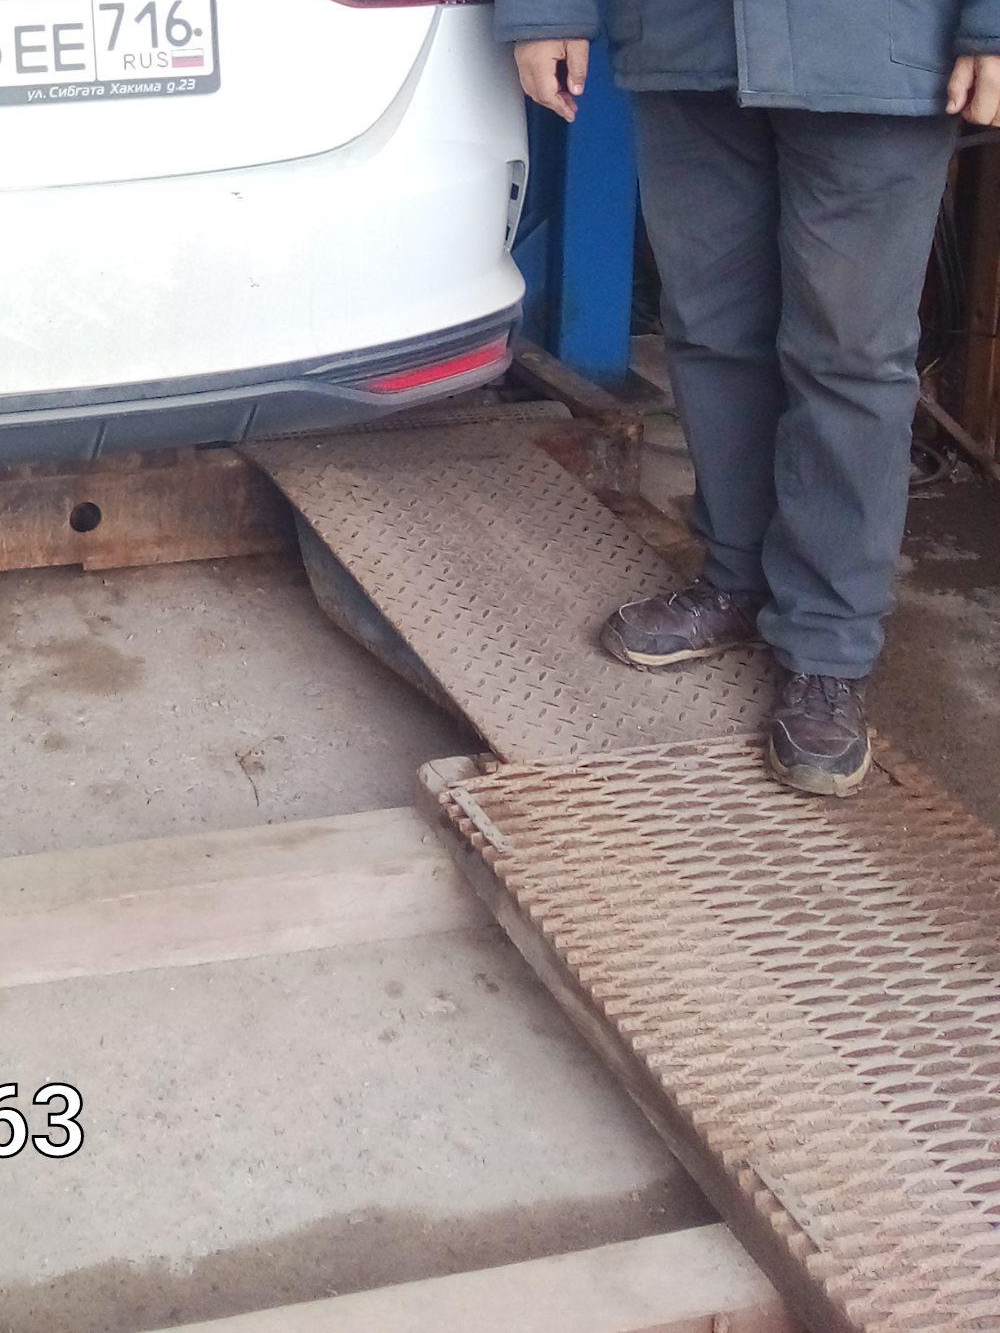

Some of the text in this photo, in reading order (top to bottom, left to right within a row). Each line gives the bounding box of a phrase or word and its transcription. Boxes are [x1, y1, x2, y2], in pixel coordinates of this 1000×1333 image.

[98, 0, 193, 52] 716
[123, 51, 169, 71] RUS
[27, 89, 47, 102] ул.
[49, 84, 105, 99] Сибгата
[109, 81, 162, 96] Хакима
